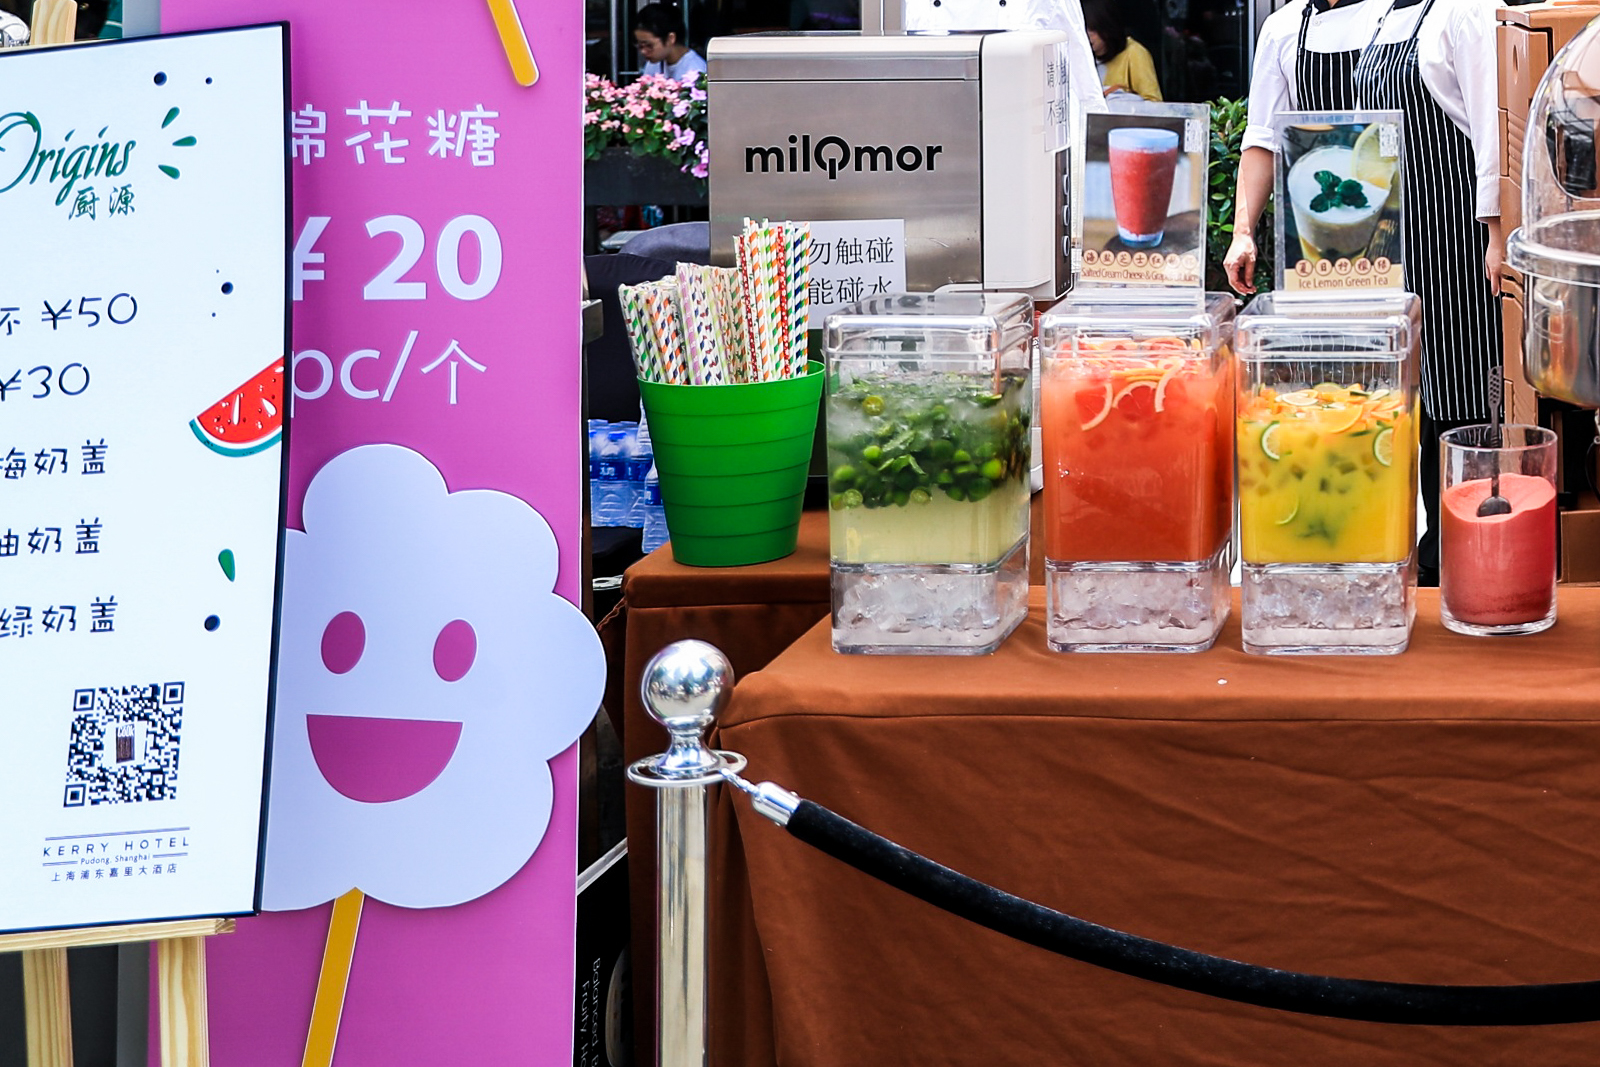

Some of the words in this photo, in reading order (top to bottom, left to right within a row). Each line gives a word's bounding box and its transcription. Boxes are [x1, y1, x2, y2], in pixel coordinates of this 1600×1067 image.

[68, 184, 135, 221] 厨源
[808, 236, 894, 265] 勿触碰
[1313, 277, 1343, 288] Lemon
[1345, 276, 1371, 287] Green
[1373, 275, 1388, 286] Tea
[0, 595, 118, 638] 绿奶盖
[43, 842, 109, 857] KERRY
[124, 837, 189, 851] HOTEL
[115, 852, 151, 863] Shanghai
[51, 863, 177, 883] 上海浦东嘉里大酒店
